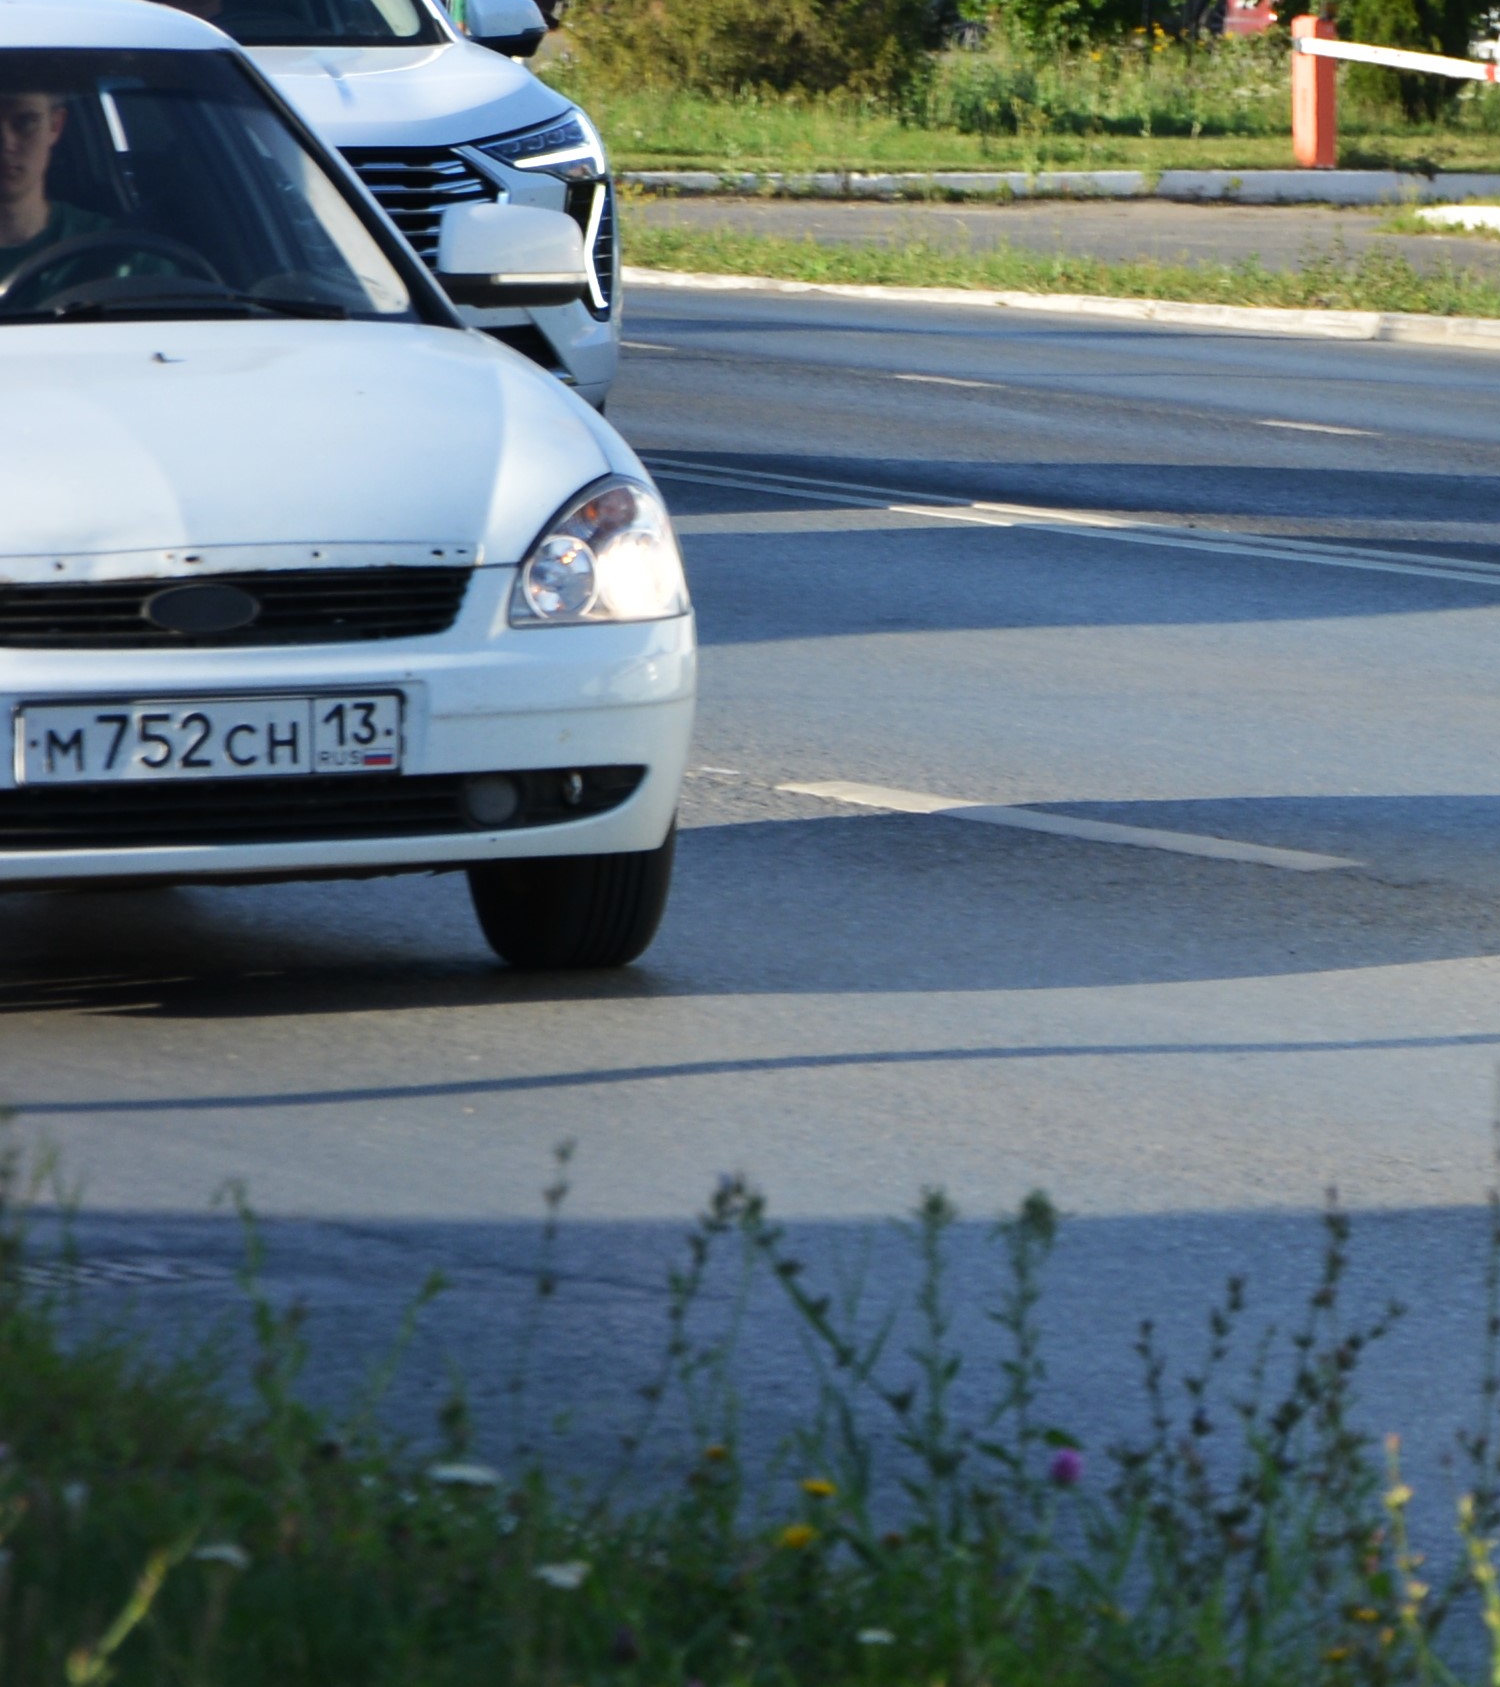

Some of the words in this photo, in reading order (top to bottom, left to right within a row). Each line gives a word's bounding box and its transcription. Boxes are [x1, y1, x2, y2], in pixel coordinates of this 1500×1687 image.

[45, 712, 299, 773] М752СН
[323, 701, 377, 747] 13
[319, 751, 361, 766] RUS
